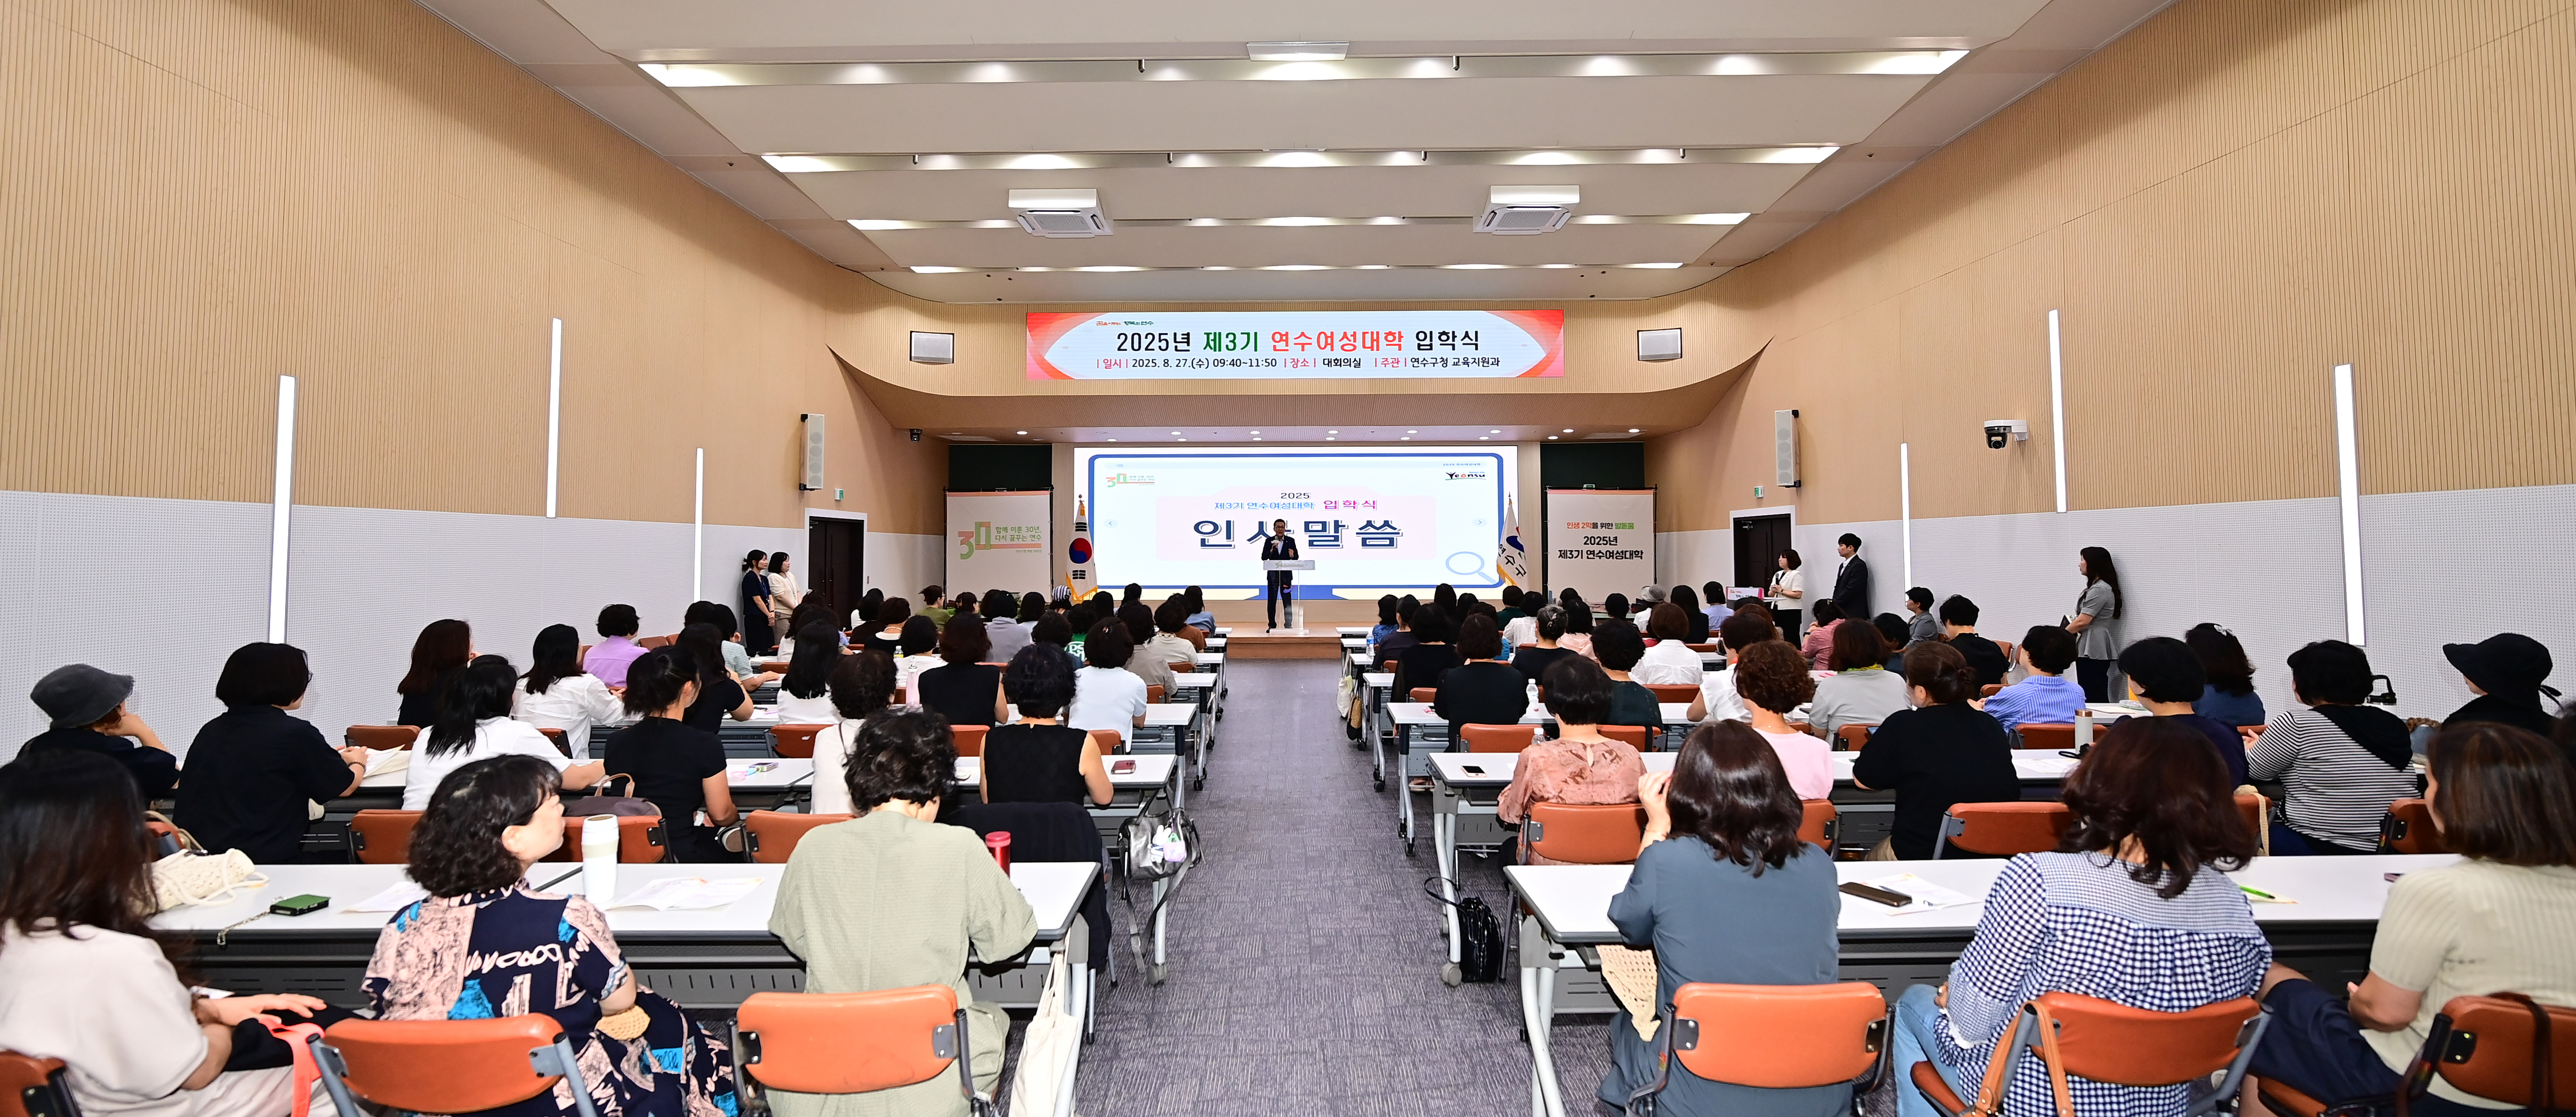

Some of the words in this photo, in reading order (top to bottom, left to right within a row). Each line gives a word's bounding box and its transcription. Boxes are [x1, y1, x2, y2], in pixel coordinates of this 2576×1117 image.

[1117, 332, 1191, 352] 2025년
[1203, 331, 1258, 352] 제3기
[1271, 331, 1404, 352] 연수여성대학
[1416, 330, 1479, 351] 입학식
[1103, 358, 1122, 369] 일시
[1132, 358, 1160, 368] 2025.
[1163, 358, 1172, 368] 8.
[1175, 358, 1210, 369] 27.(수)
[1212, 358, 1277, 368] 09:40~11:50
[1290, 357, 1310, 369] 장소
[1322, 357, 1361, 368] 대회의실
[1381, 357, 1401, 368] 주관
[1411, 357, 1448, 368] 연수구청
[1452, 357, 1501, 368] 교육지원과
[1445, 472, 1485, 480] Yeonsu
[1214, 502, 1244, 510] 제3기
[1247, 502, 1315, 510] 연수여성대학
[1323, 500, 1377, 510] 입학식
[1583, 536, 1618, 546] 2025년
[1558, 550, 1583, 559] 제3기
[1586, 550, 1644, 560] 연수여성대학
